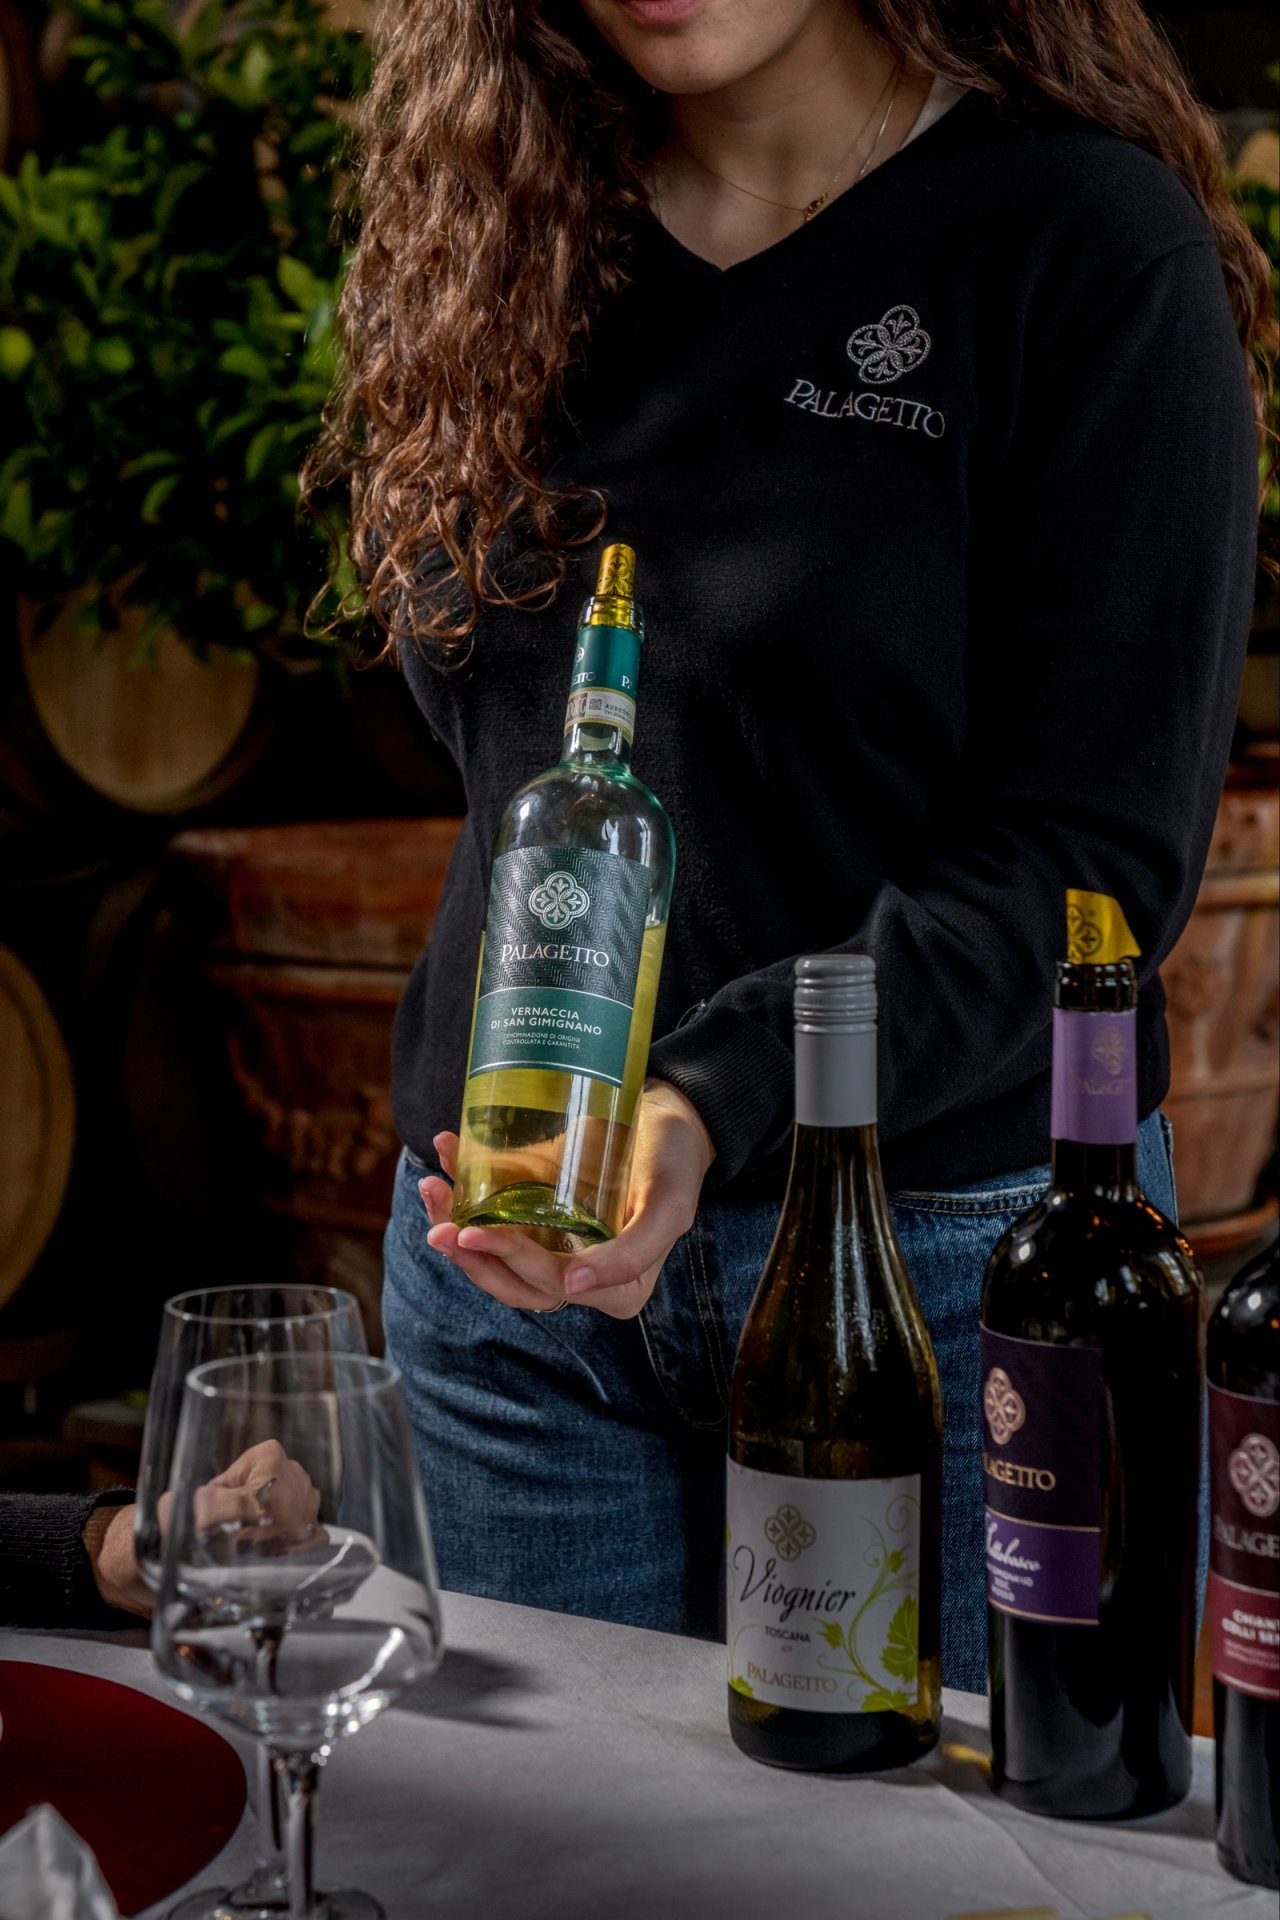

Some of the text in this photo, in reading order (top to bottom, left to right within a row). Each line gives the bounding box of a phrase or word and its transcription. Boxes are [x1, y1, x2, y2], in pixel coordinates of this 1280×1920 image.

[784, 378, 945, 438] PALAGETTO
[501, 943, 610, 967] PALAGETTO
[511, 1007, 580, 1020] VERNACCIA
[490, 1017, 602, 1036] DI SAN GIMIGNANO
[503, 1032, 548, 1040] DENOMINAZIONE
[557, 1034, 581, 1043] ORIGINE
[733, 1545, 856, 1623] Viognier
[765, 1625, 811, 1643] TOSCANA
[747, 1661, 838, 1693] PALAGETTO
